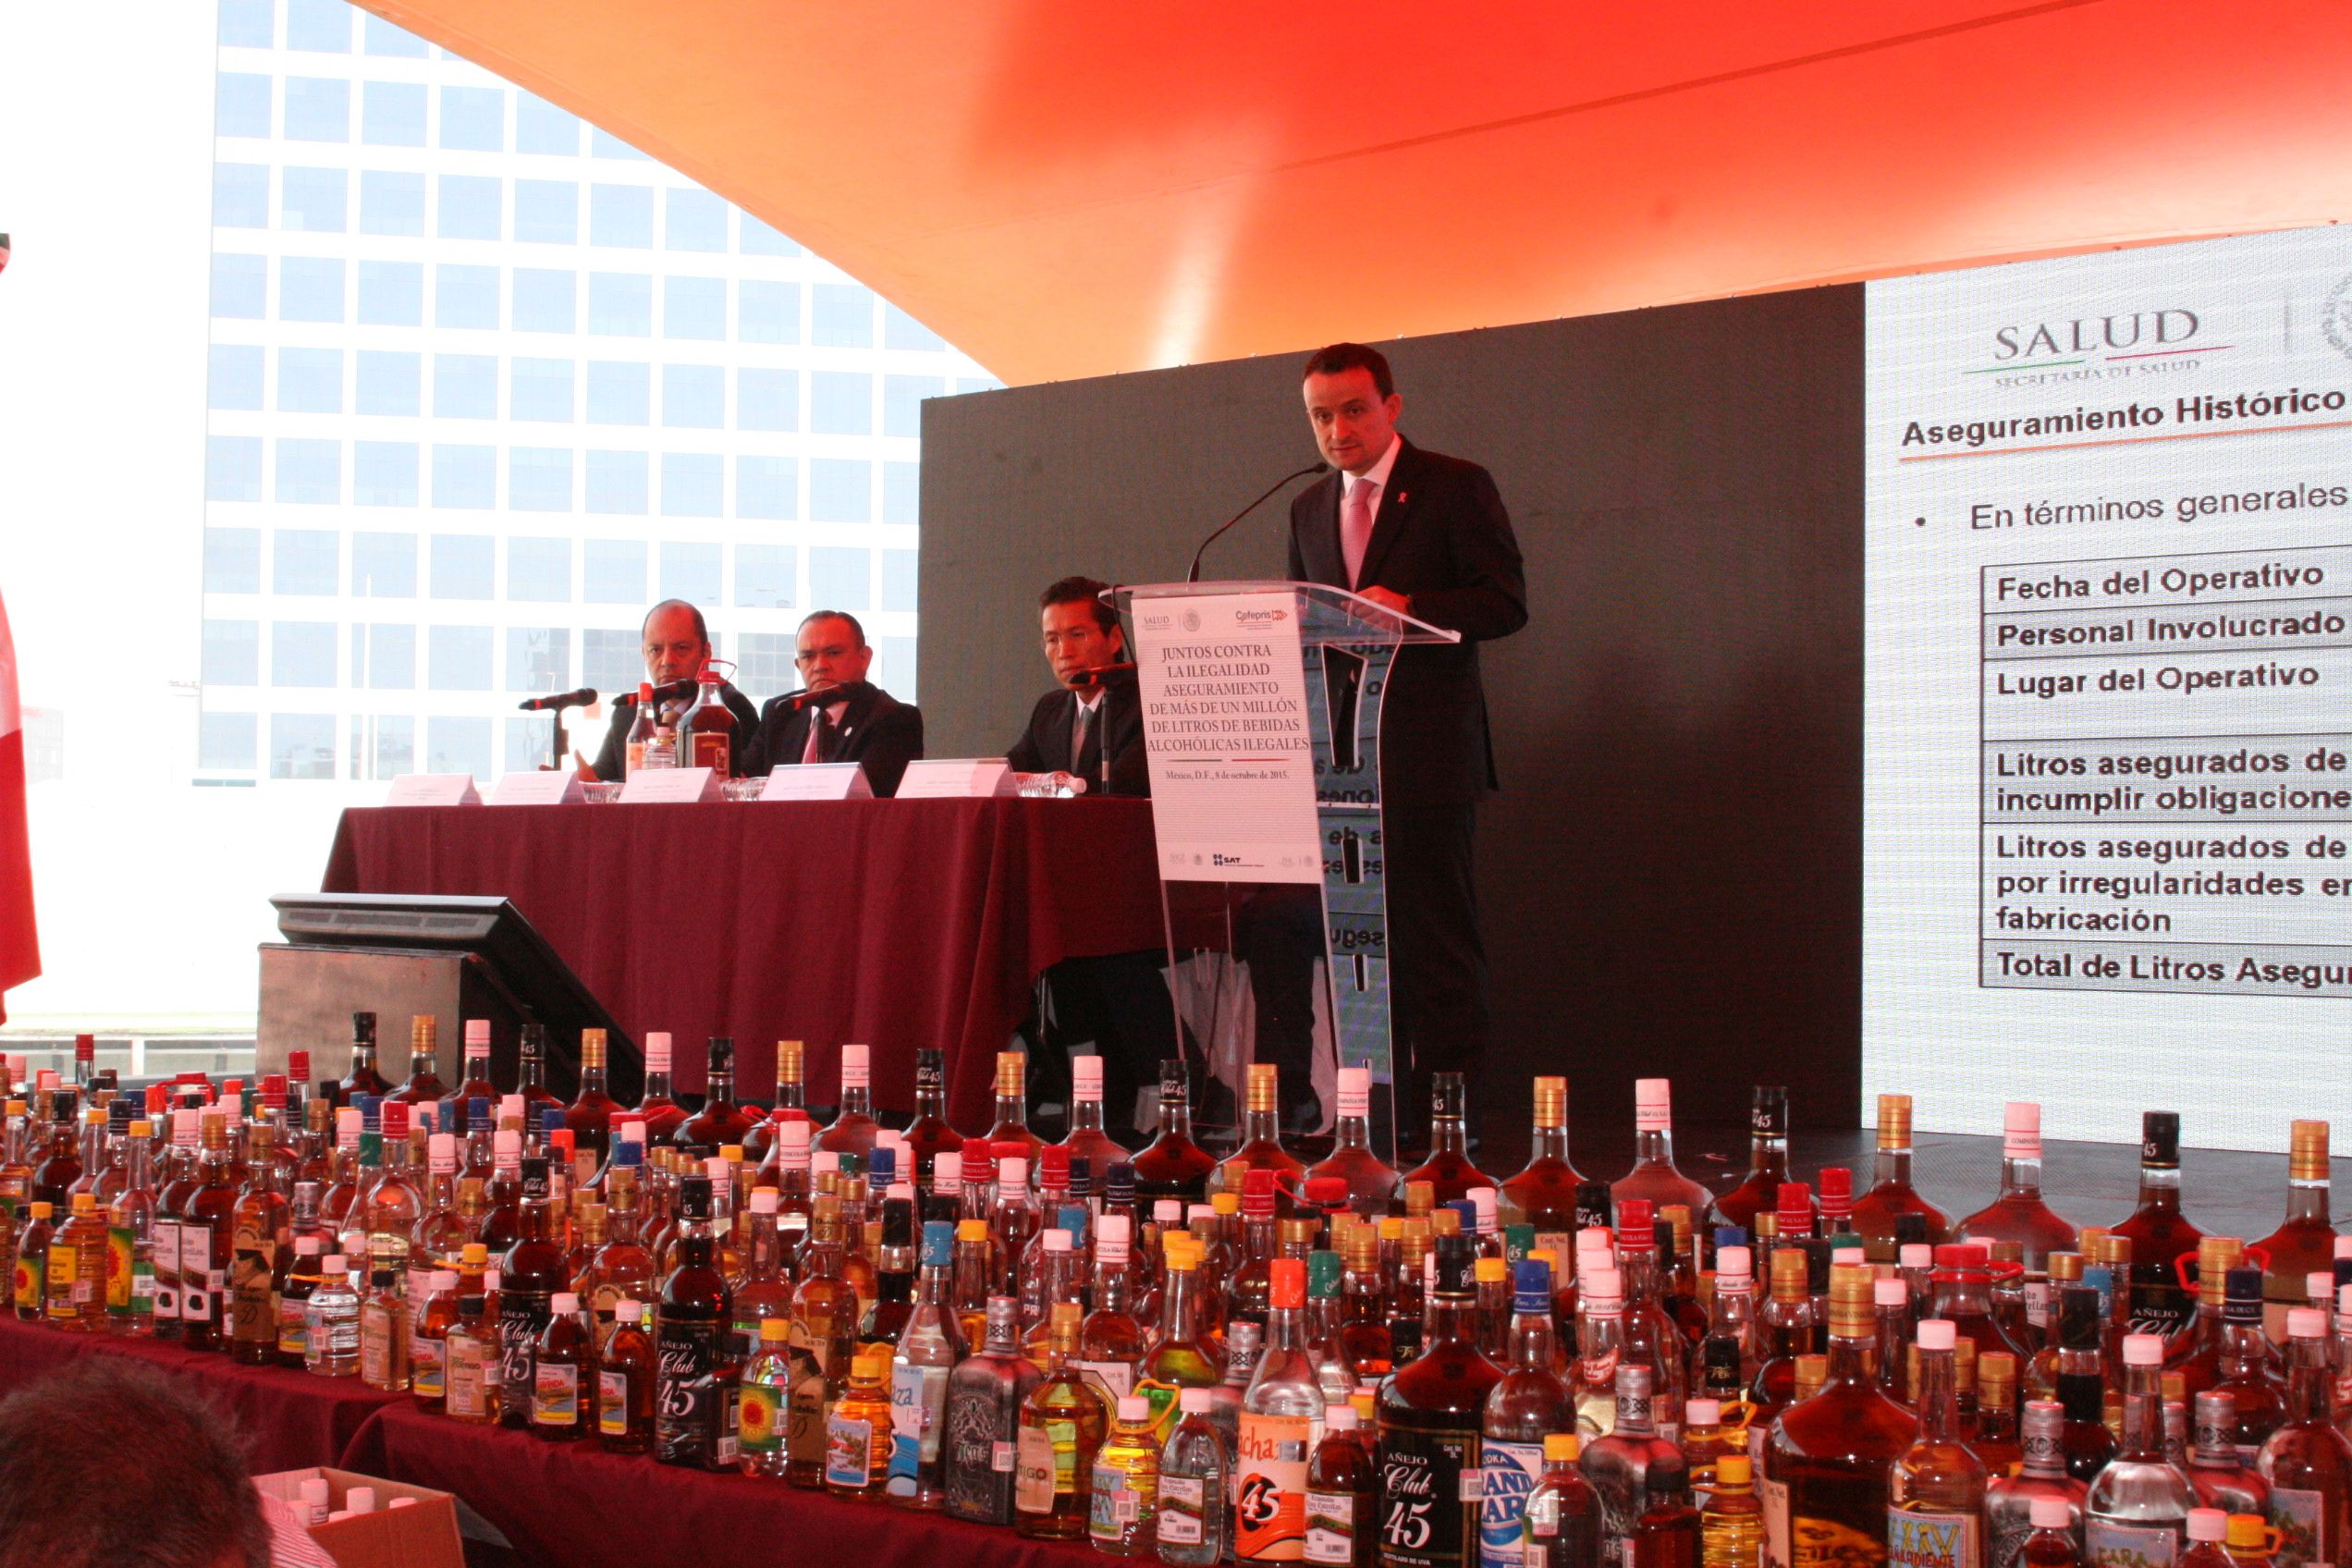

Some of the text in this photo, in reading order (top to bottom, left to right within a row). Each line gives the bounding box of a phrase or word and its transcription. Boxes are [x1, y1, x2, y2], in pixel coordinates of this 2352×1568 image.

[1993, 307, 2200, 361] SALUD
[1901, 387, 2346, 447] Aseguramiento Histórico
[1971, 482, 2349, 531] En términos generales
[1997, 560, 2324, 602] Fecha del Operativo
[1235, 610, 1272, 623] Cofepris
[1997, 610, 2346, 647] Personal Involucrado
[1161, 644, 1272, 663] JUNTOS CONTRA
[1167, 663, 1271, 679] LA ILEGALIDAD
[1997, 662, 2320, 699] Lugar del Operativo
[1163, 681, 1280, 697] ASEGURAMIENTO
[1149, 696, 1298, 716] DE MÁS DE UN MILLÓN
[1151, 717, 1301, 734] DE LITROS DE BEBIDAS
[1146, 736, 1310, 753] ALCOHÓLICAS ILEGALES
[1220, 769, 1231, 779] de
[1231, 769, 1258, 779] octubre
[1258, 769, 1268, 779] de
[1997, 747, 2348, 780] Litros asegurados de
[1997, 785, 2147, 815] incumplir
[1997, 835, 2348, 864] Litros asegurados de
[1997, 876, 2051, 898] por
[2058, 871, 2305, 900] irregularidades
[1995, 905, 2173, 933] fabricación
[1997, 951, 2072, 978] Total
[2081, 953, 2121, 978] de
[2130, 955, 2226, 983] Litros
[1756, 1114, 1772, 1129] 45
[1586, 1213, 1603, 1227] 45
[501, 1310, 532, 1319] AÑEJO
[2133, 1307, 2179, 1318] AÑEJO
[660, 1341, 693, 1351] AÑEJO
[501, 1345, 532, 1382] 45
[657, 1350, 696, 1378] Club
[657, 1378, 697, 1416] 45
[1387, 1452, 1428, 1466] AÑEJO
[1383, 1464, 1433, 1500] Club
[1241, 1482, 1281, 1523] 45
[1383, 1501, 1433, 1550] 45
[1418, 1557, 1431, 1566] UVA
